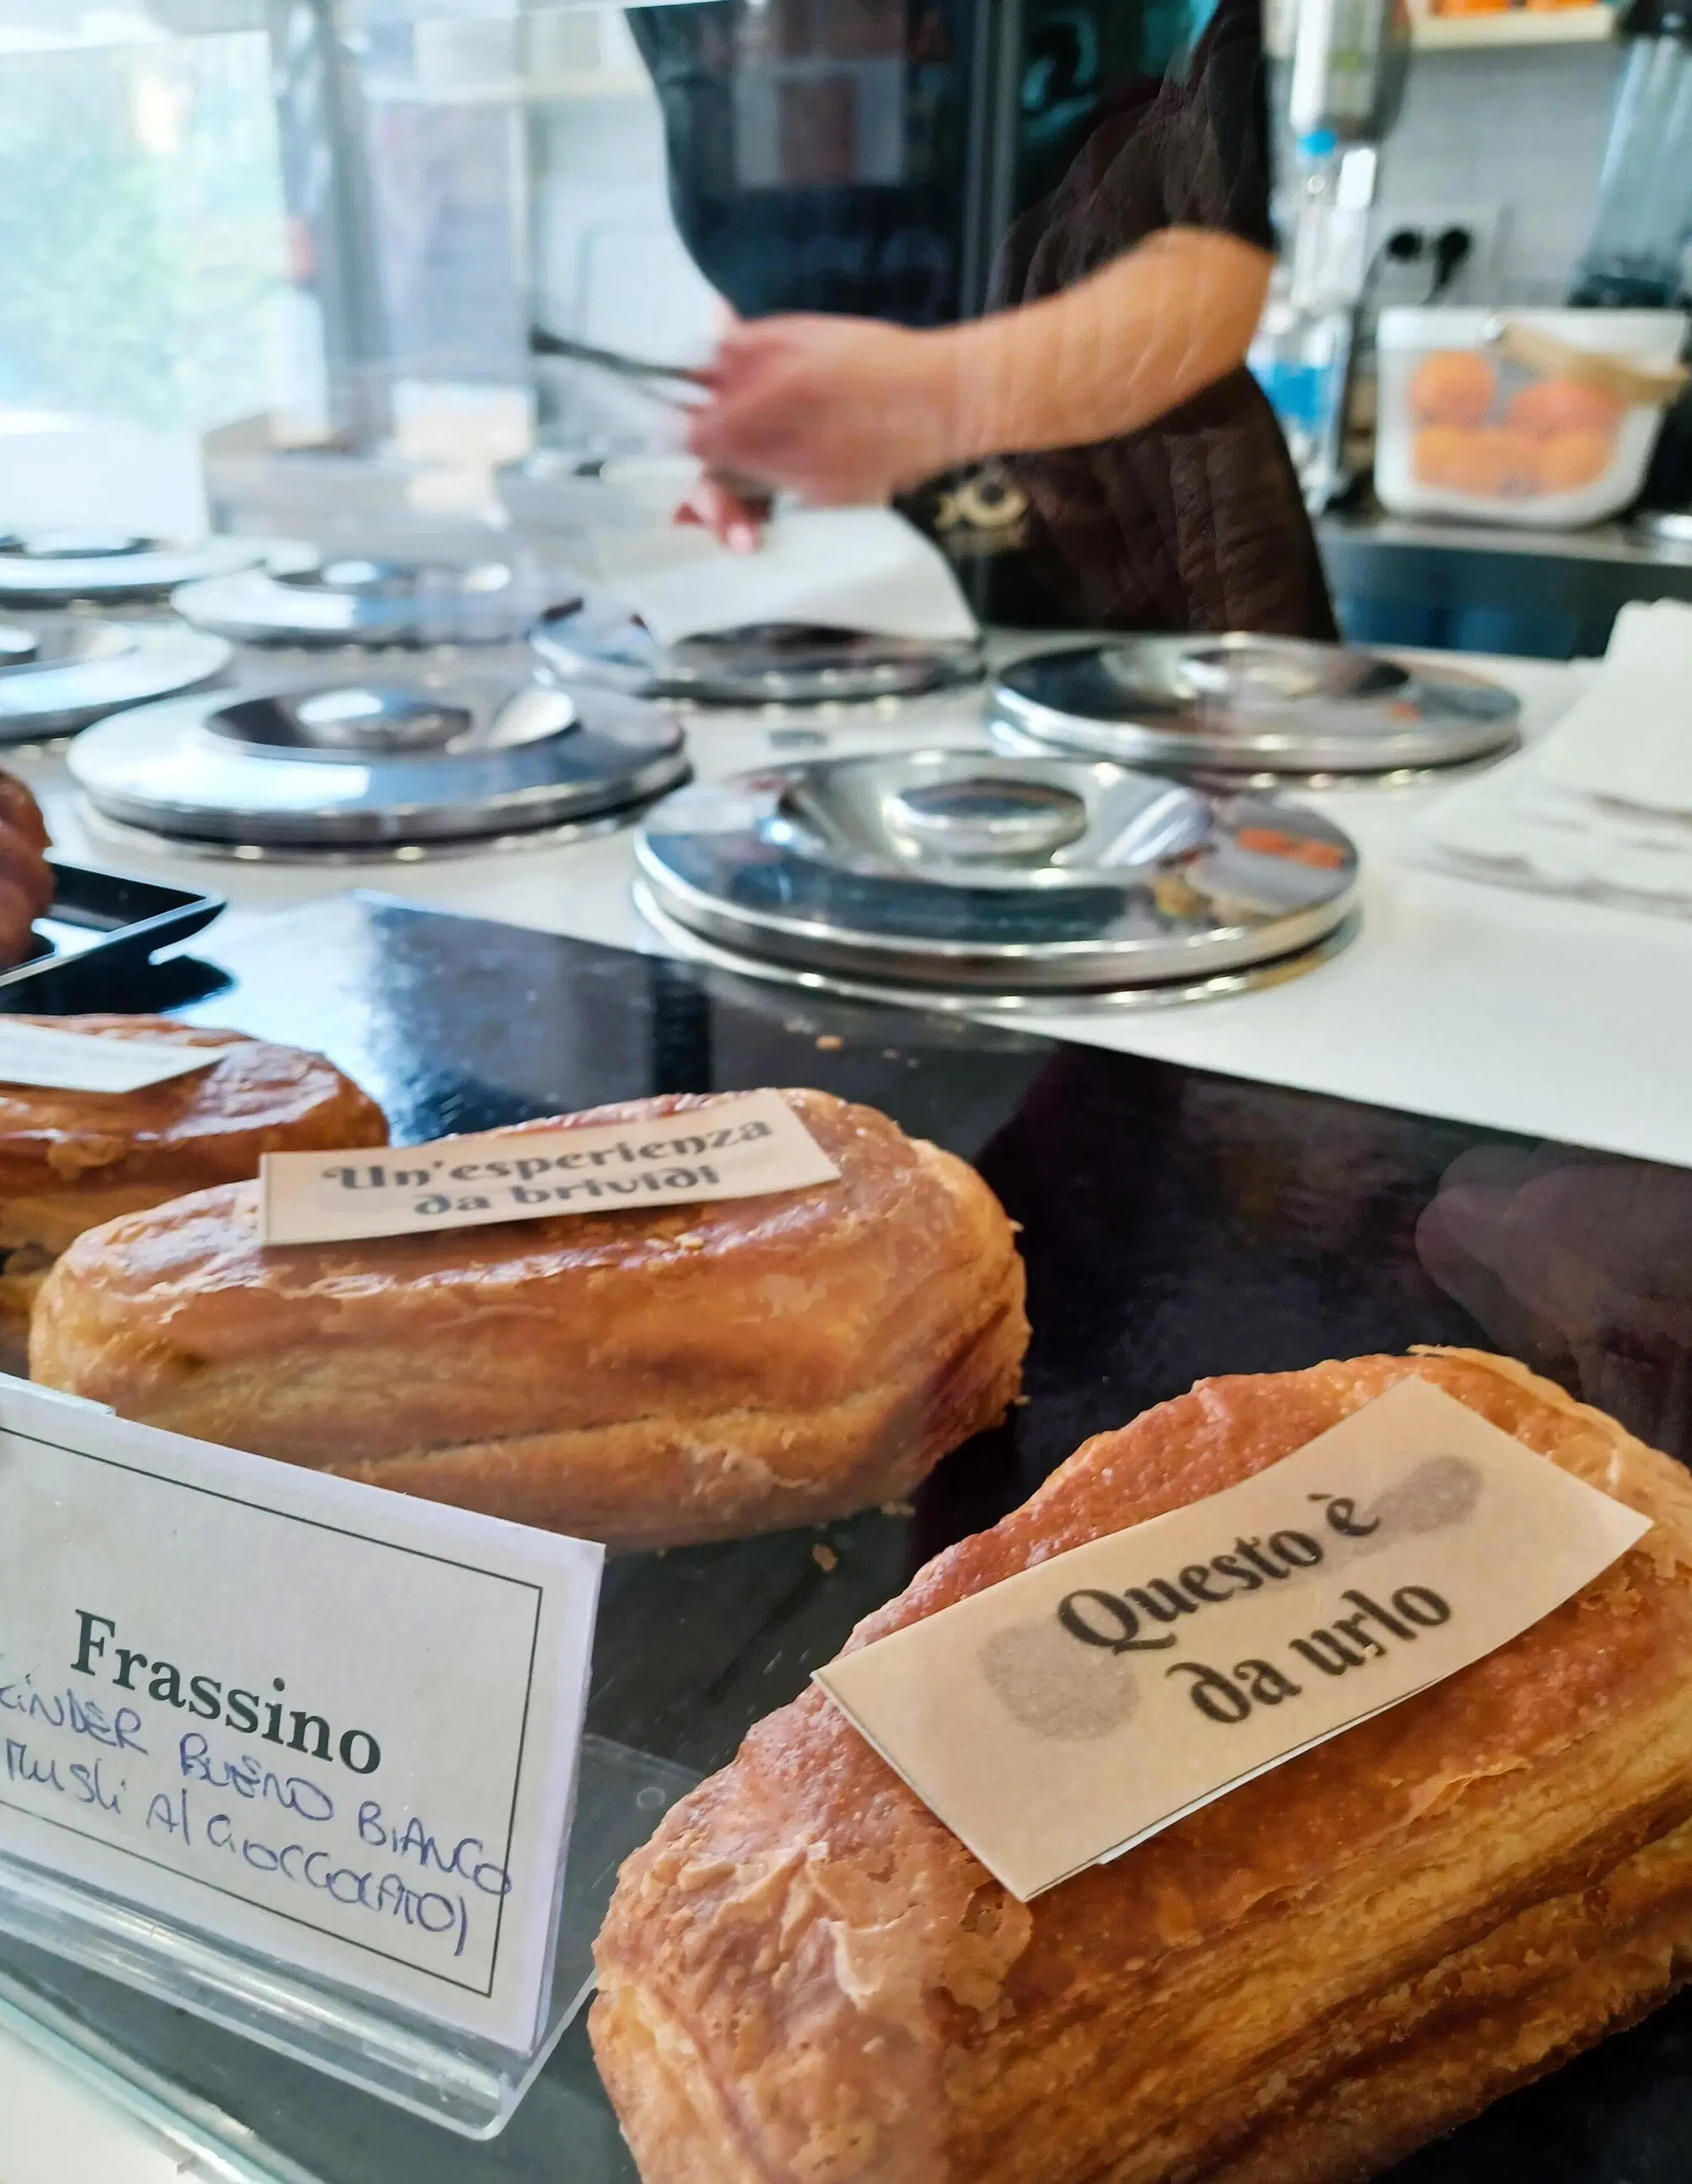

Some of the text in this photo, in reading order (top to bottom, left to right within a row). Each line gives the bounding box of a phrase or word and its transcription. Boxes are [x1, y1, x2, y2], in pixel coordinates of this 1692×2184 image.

[322, 1120, 772, 1189] Un'esperienza
[414, 1164, 721, 1216] da brividi
[1058, 1493, 1381, 1654] Questo è
[70, 1609, 382, 1774] Frassino
[1165, 1585, 1453, 1725] da urlo
